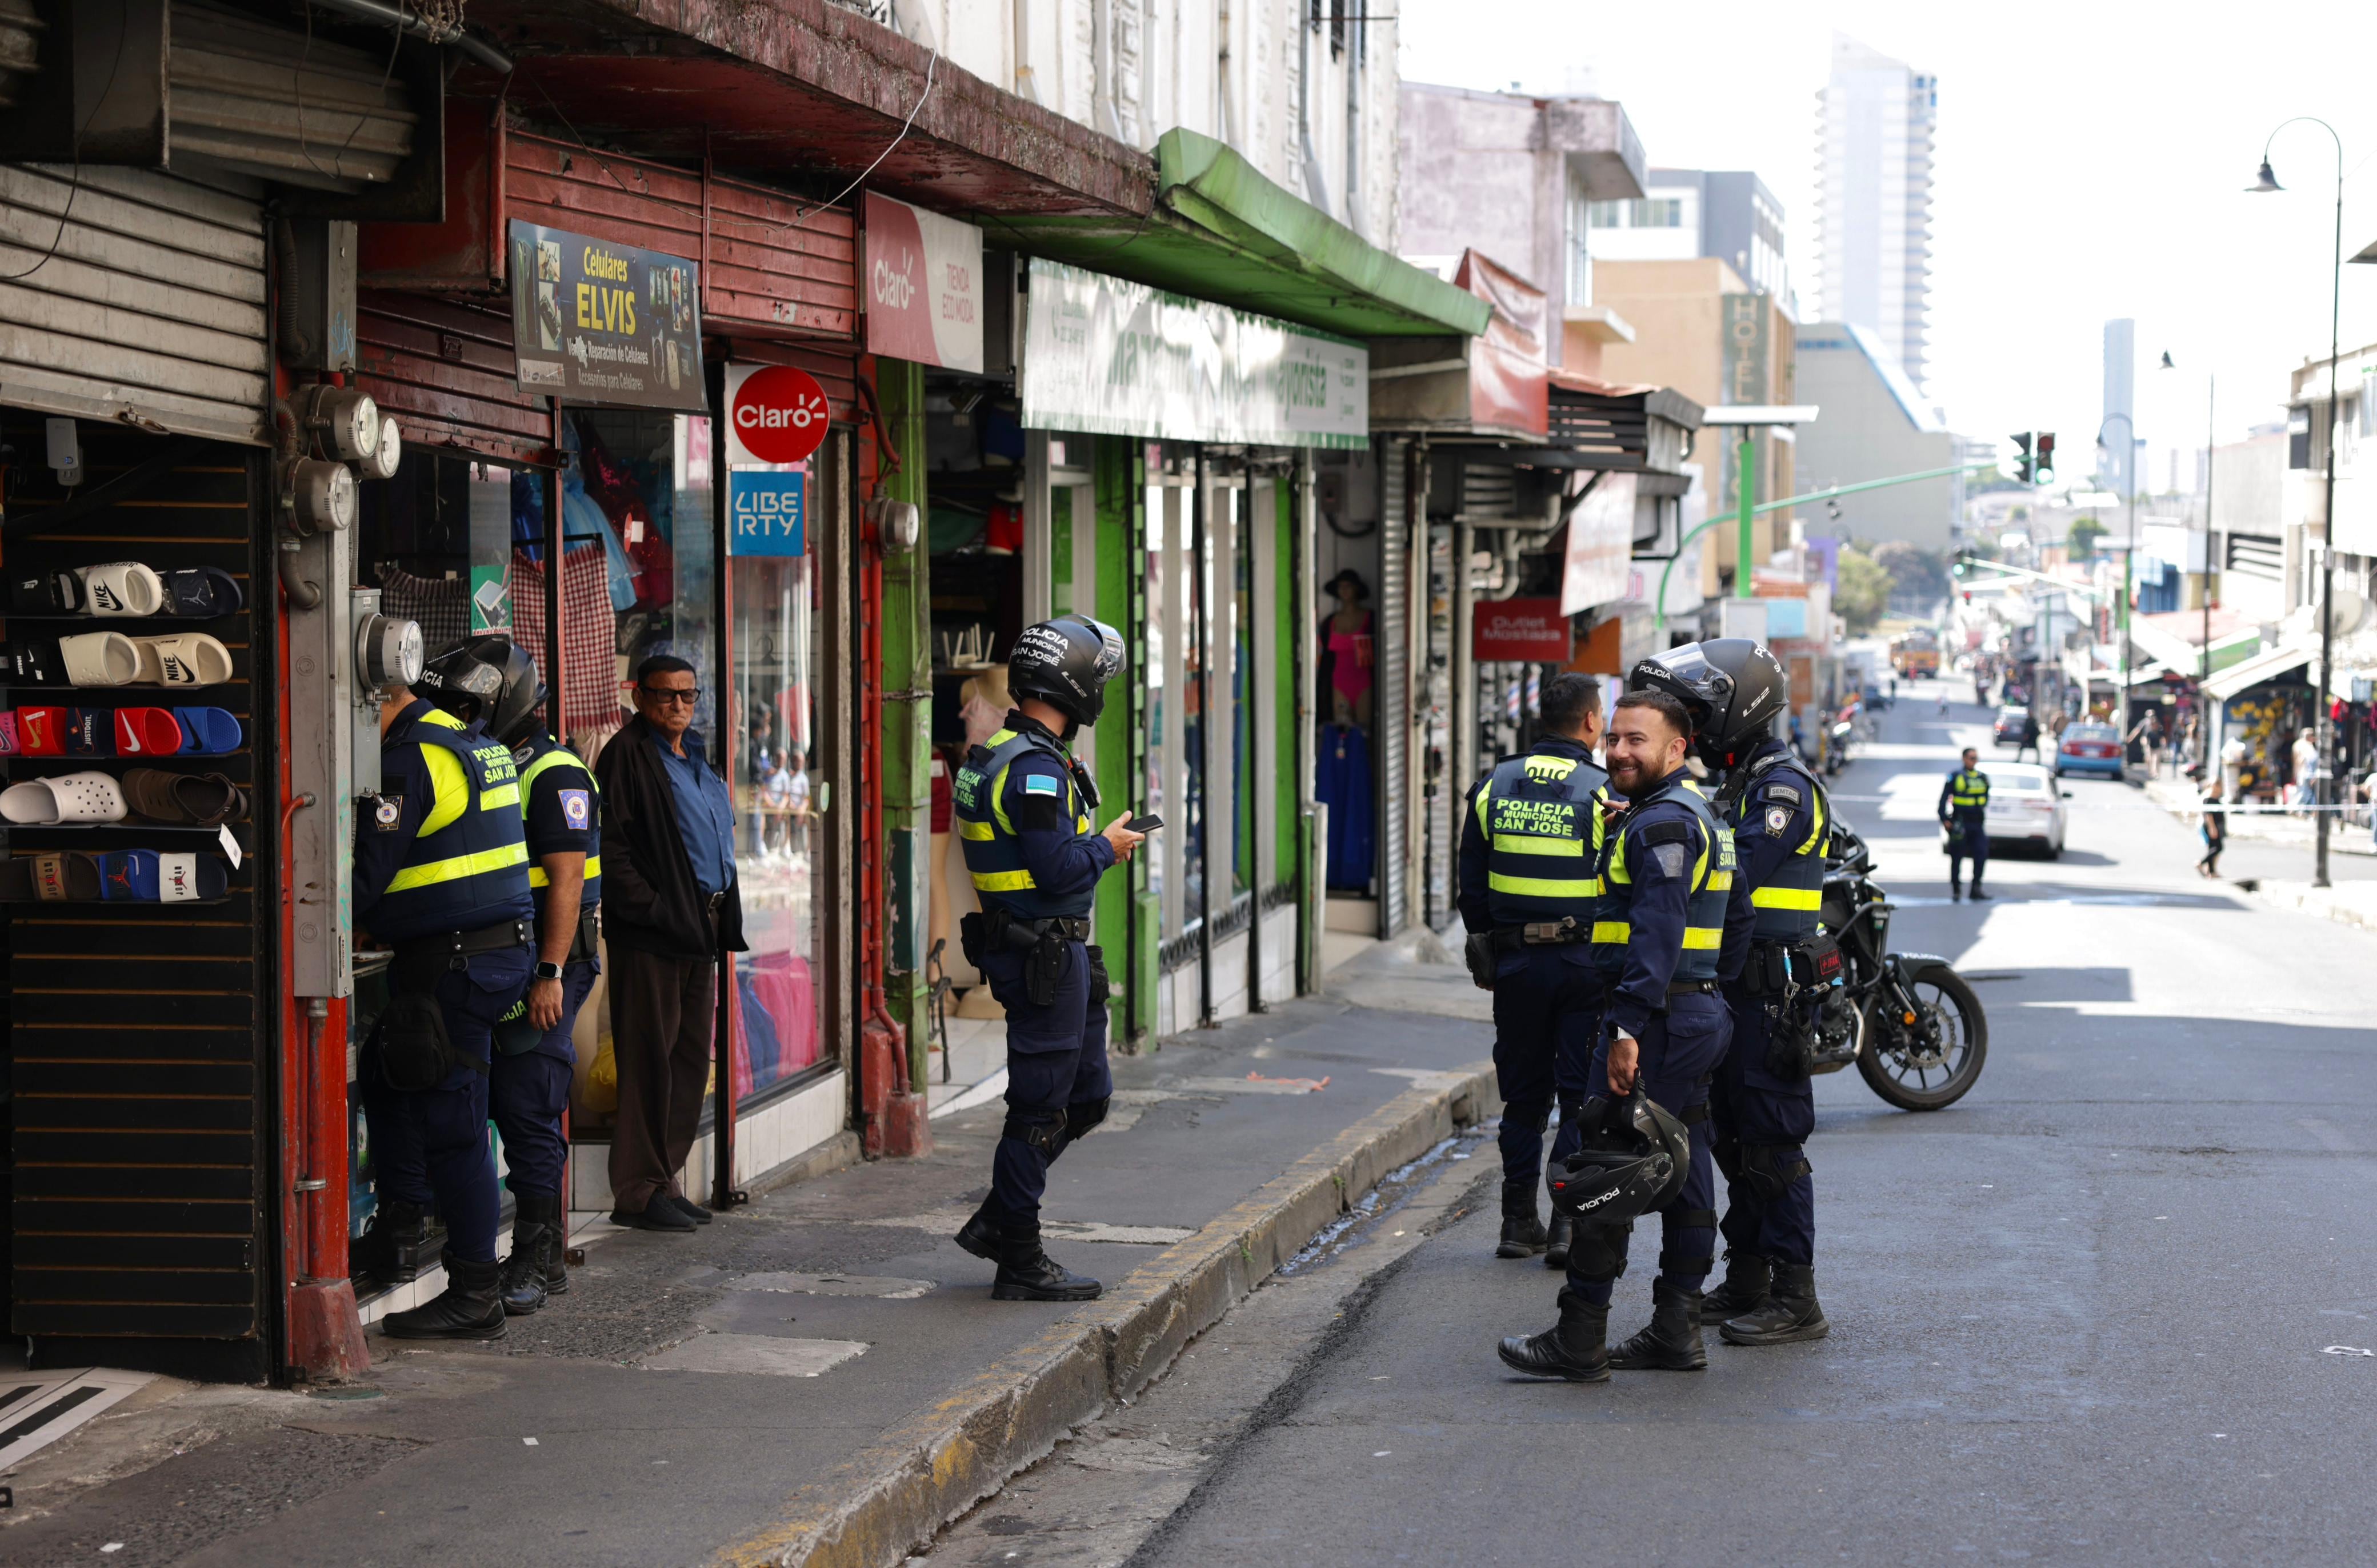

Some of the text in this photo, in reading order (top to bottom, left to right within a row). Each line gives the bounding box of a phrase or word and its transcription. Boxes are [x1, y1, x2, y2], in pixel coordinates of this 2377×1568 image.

[584, 246, 627, 282] Celulares
[875, 258, 910, 310] Claro
[946, 263, 970, 293] TIENDA
[577, 282, 636, 335] ELVIS
[588, 341, 617, 363] Reparación
[618, 345, 624, 362] de
[625, 345, 649, 365] Celulares
[1732, 297, 1758, 403] HOTEL
[578, 367, 606, 388] Accesorios
[607, 375, 619, 393] para
[619, 372, 644, 391] Celulares
[737, 403, 813, 428] Claro
[735, 492, 799, 513] LIBE
[738, 515, 797, 535] RTY
[94, 585, 111, 609] NIKE
[1491, 615, 1546, 628] Outlet
[1482, 627, 1561, 641] Mostaza
[1012, 647, 1061, 667] SAN JOSÉ
[1022, 637, 1066, 659] MUNICIPAL
[163, 657, 181, 681] NIKE
[1638, 665, 1671, 681] POLICIA
[1061, 671, 1088, 698] LS2
[1743, 686, 1770, 717] LS2
[472, 745, 513, 762] POLICIA
[485, 765, 518, 783] SAN JOS
[1772, 788, 1797, 798] SEMTAC
[1496, 799, 1575, 817] POLICIA
[1503, 810, 1564, 823] MUNICIPAL
[1768, 806, 1789, 817] POLICIA
[1494, 818, 1573, 837] SAN JOSE
[1577, 1187, 1620, 1211] POLICIA
